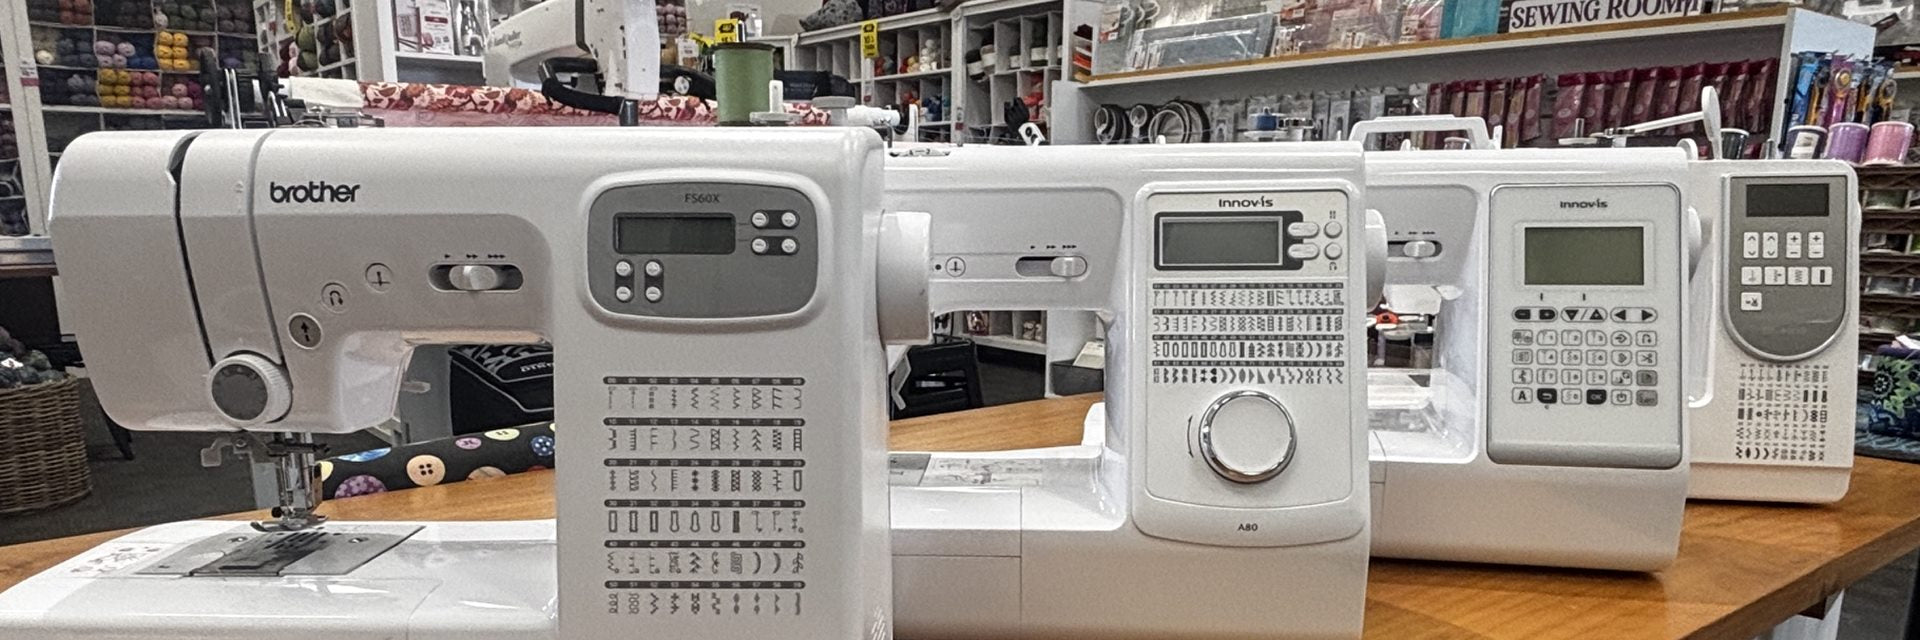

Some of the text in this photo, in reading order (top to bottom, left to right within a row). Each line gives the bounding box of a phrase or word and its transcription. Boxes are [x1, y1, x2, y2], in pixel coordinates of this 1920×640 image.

[1511, 0, 1600, 29] SEWING
[270, 181, 361, 203] brother
[684, 194, 721, 204] FS60X
[1518, 391, 1527, 401] A
[1237, 523, 1258, 532] A80
